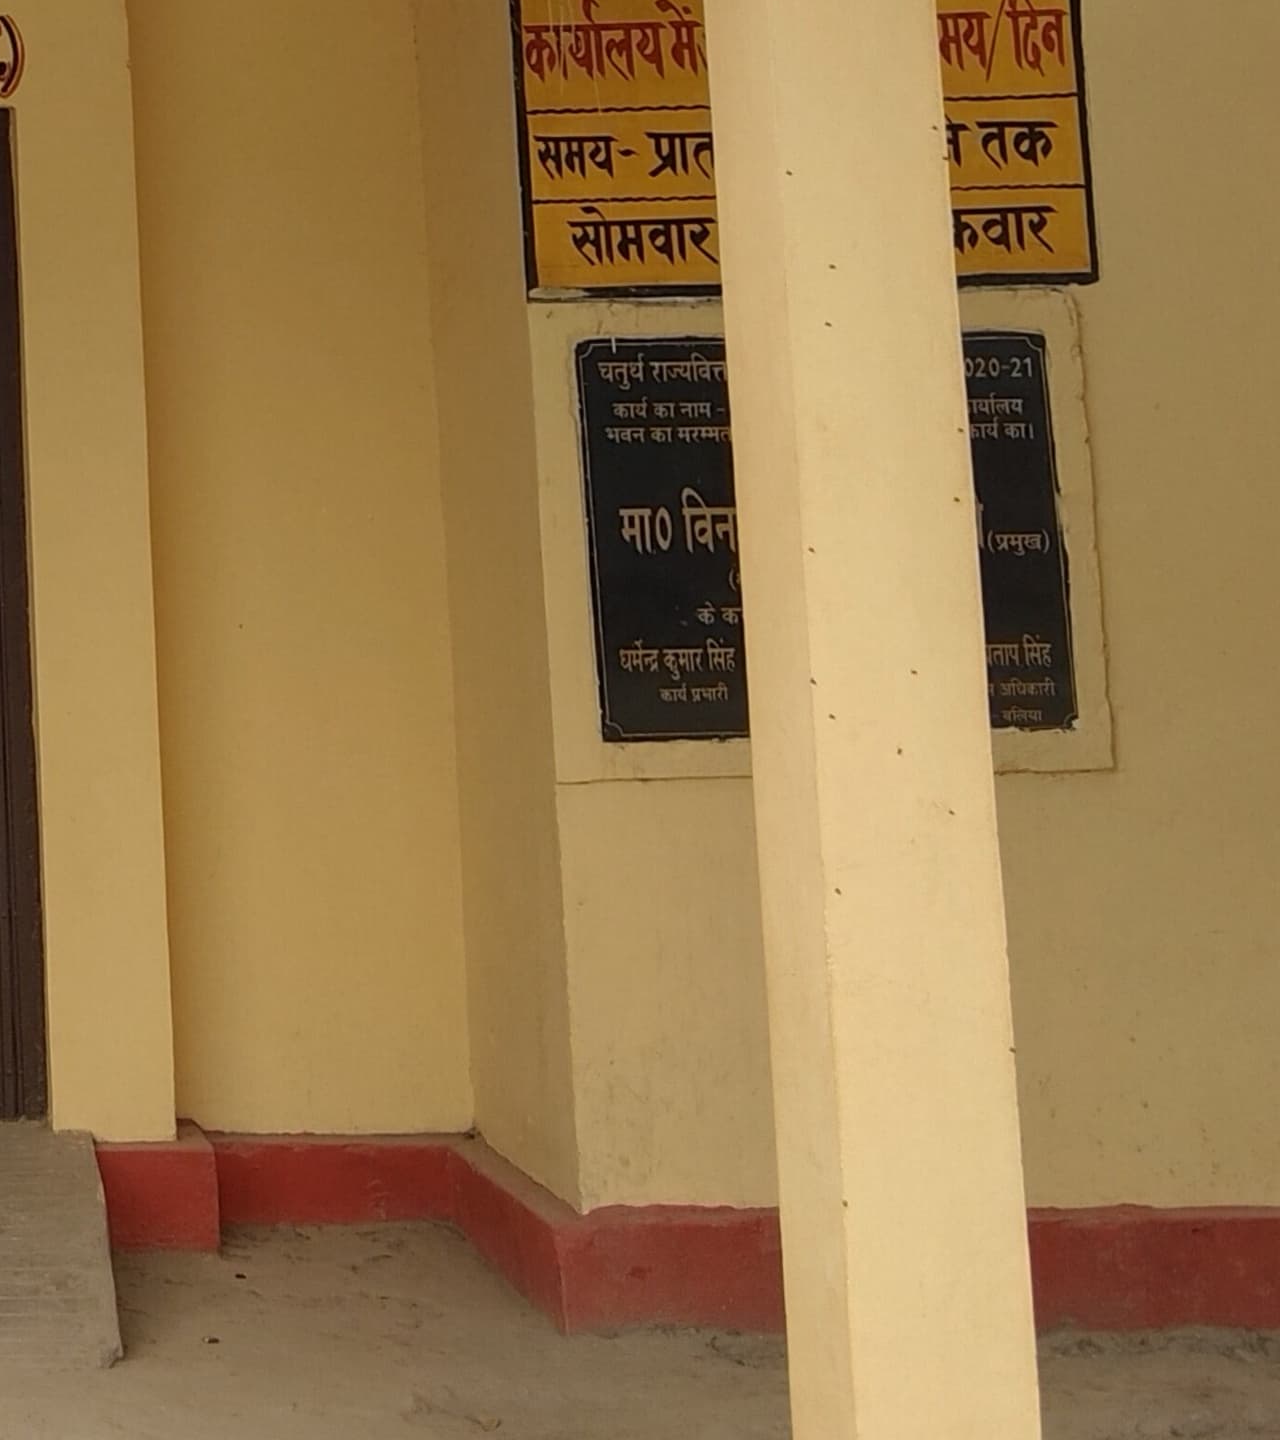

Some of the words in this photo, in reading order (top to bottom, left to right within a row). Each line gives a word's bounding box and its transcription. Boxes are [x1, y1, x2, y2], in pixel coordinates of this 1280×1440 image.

[975, 120, 1059, 172] तक
[567, 205, 719, 267] सोमवार
[965, 356, 1034, 379] 020-21
[612, 396, 648, 420] कार्य
[653, 402, 676, 420] का
[679, 402, 712, 420] नाम
[968, 391, 1024, 416] ार्यालय
[604, 426, 645, 444] भवन
[650, 426, 673, 444] का
[986, 528, 1051, 558] (प्रमुख)
[662, 648, 704, 681] कुमार
[705, 637, 737, 673] सिंह
[986, 643, 1020, 668] ताप
[1022, 633, 1053, 669] सिंह
